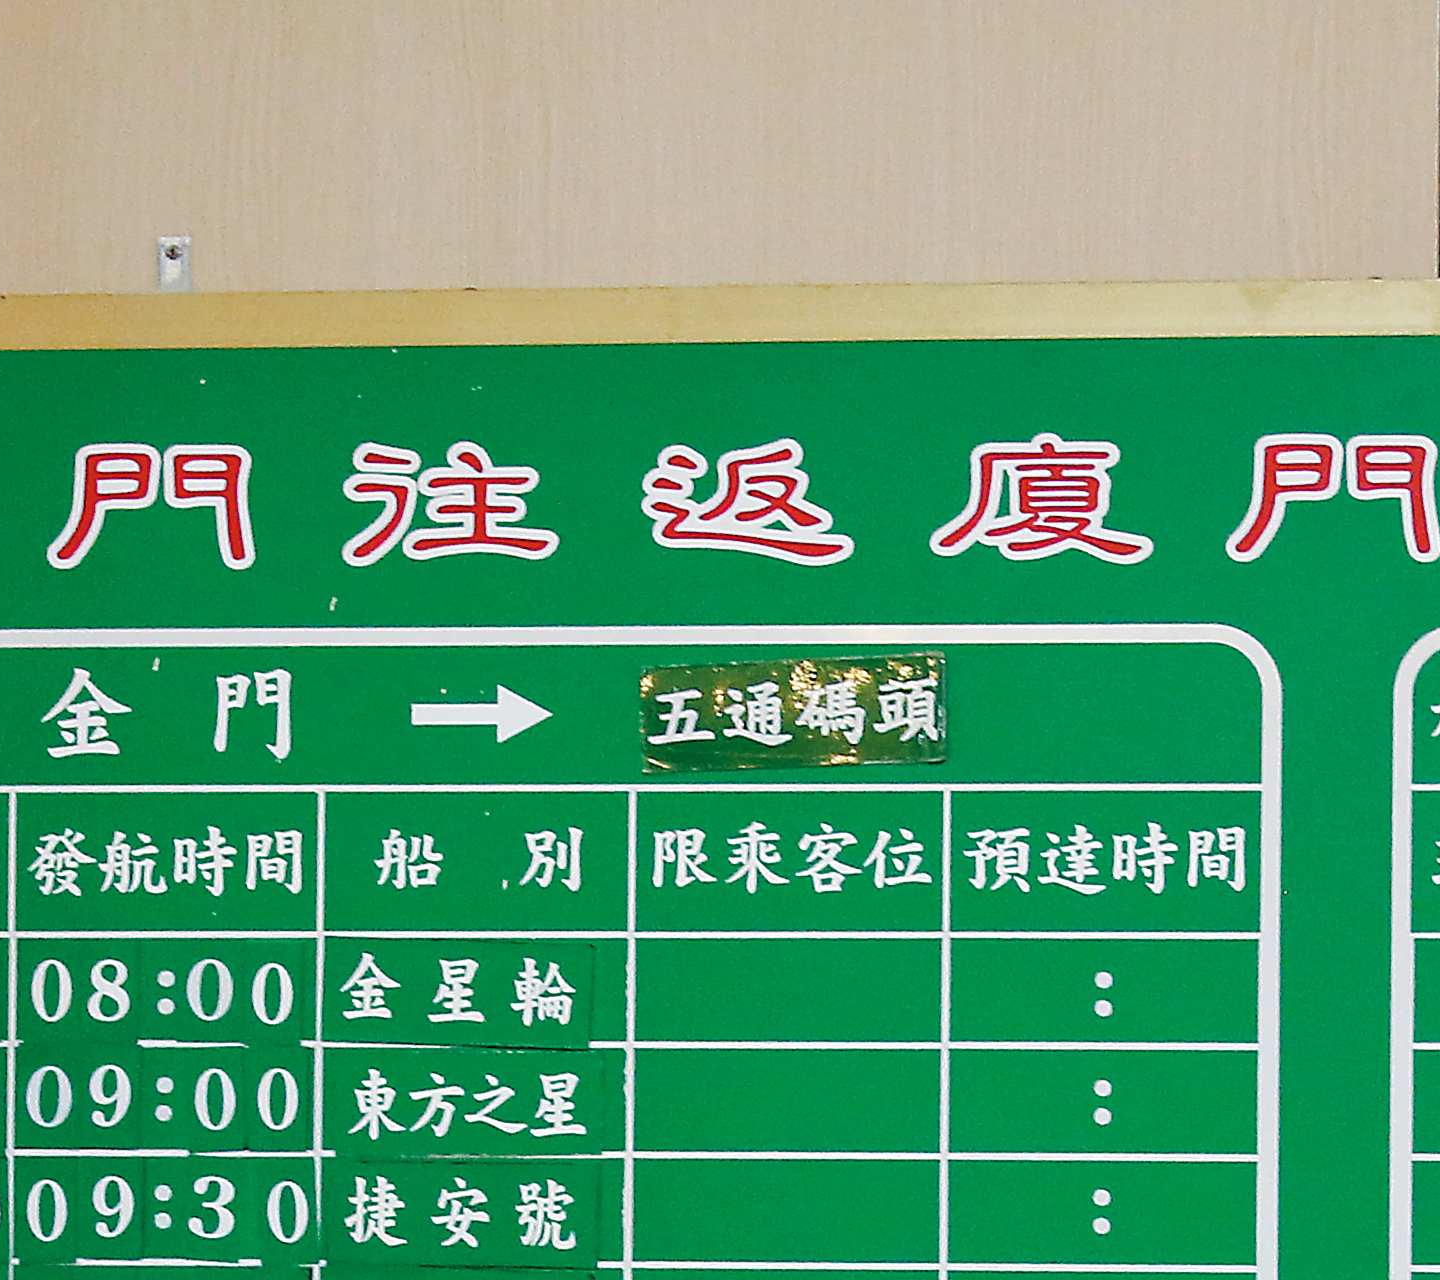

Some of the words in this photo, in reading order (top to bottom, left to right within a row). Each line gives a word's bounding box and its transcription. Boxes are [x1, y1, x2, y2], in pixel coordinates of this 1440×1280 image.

[41, 668, 291, 759] 金門
[648, 677, 939, 747] 五通碼頭
[28, 826, 302, 896] 發航時間
[374, 827, 583, 891] 船別
[653, 822, 932, 893] 限乘客位
[963, 823, 1245, 894] 預達時間
[32, 959, 293, 1024] 08:00
[340, 953, 576, 1026] 金星輪
[26, 1065, 298, 1130] 09:00
[348, 1069, 586, 1140] 東方之星
[27, 1172, 311, 1244] 09:30
[344, 1176, 576, 1249] 捷安號
